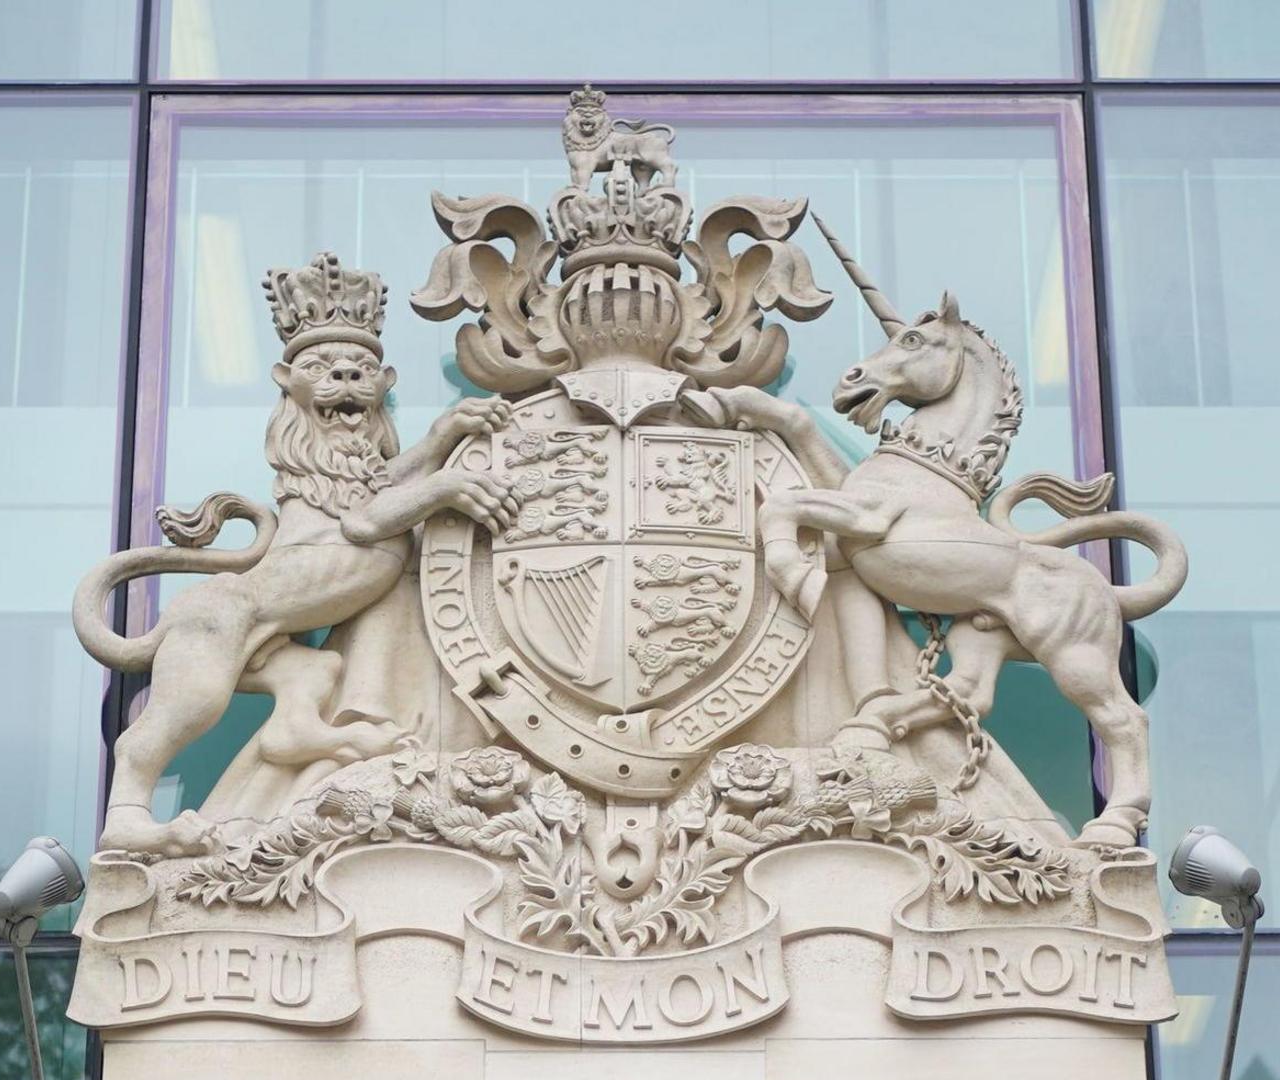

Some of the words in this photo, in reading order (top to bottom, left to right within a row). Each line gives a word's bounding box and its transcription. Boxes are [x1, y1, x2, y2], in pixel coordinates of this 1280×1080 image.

[427, 545, 490, 669] HONI
[670, 617, 809, 746] PENSE
[118, 944, 317, 1012] DIEU
[472, 943, 568, 1023] ET
[583, 944, 769, 1030] MON
[910, 943, 1148, 1010] DROIT
